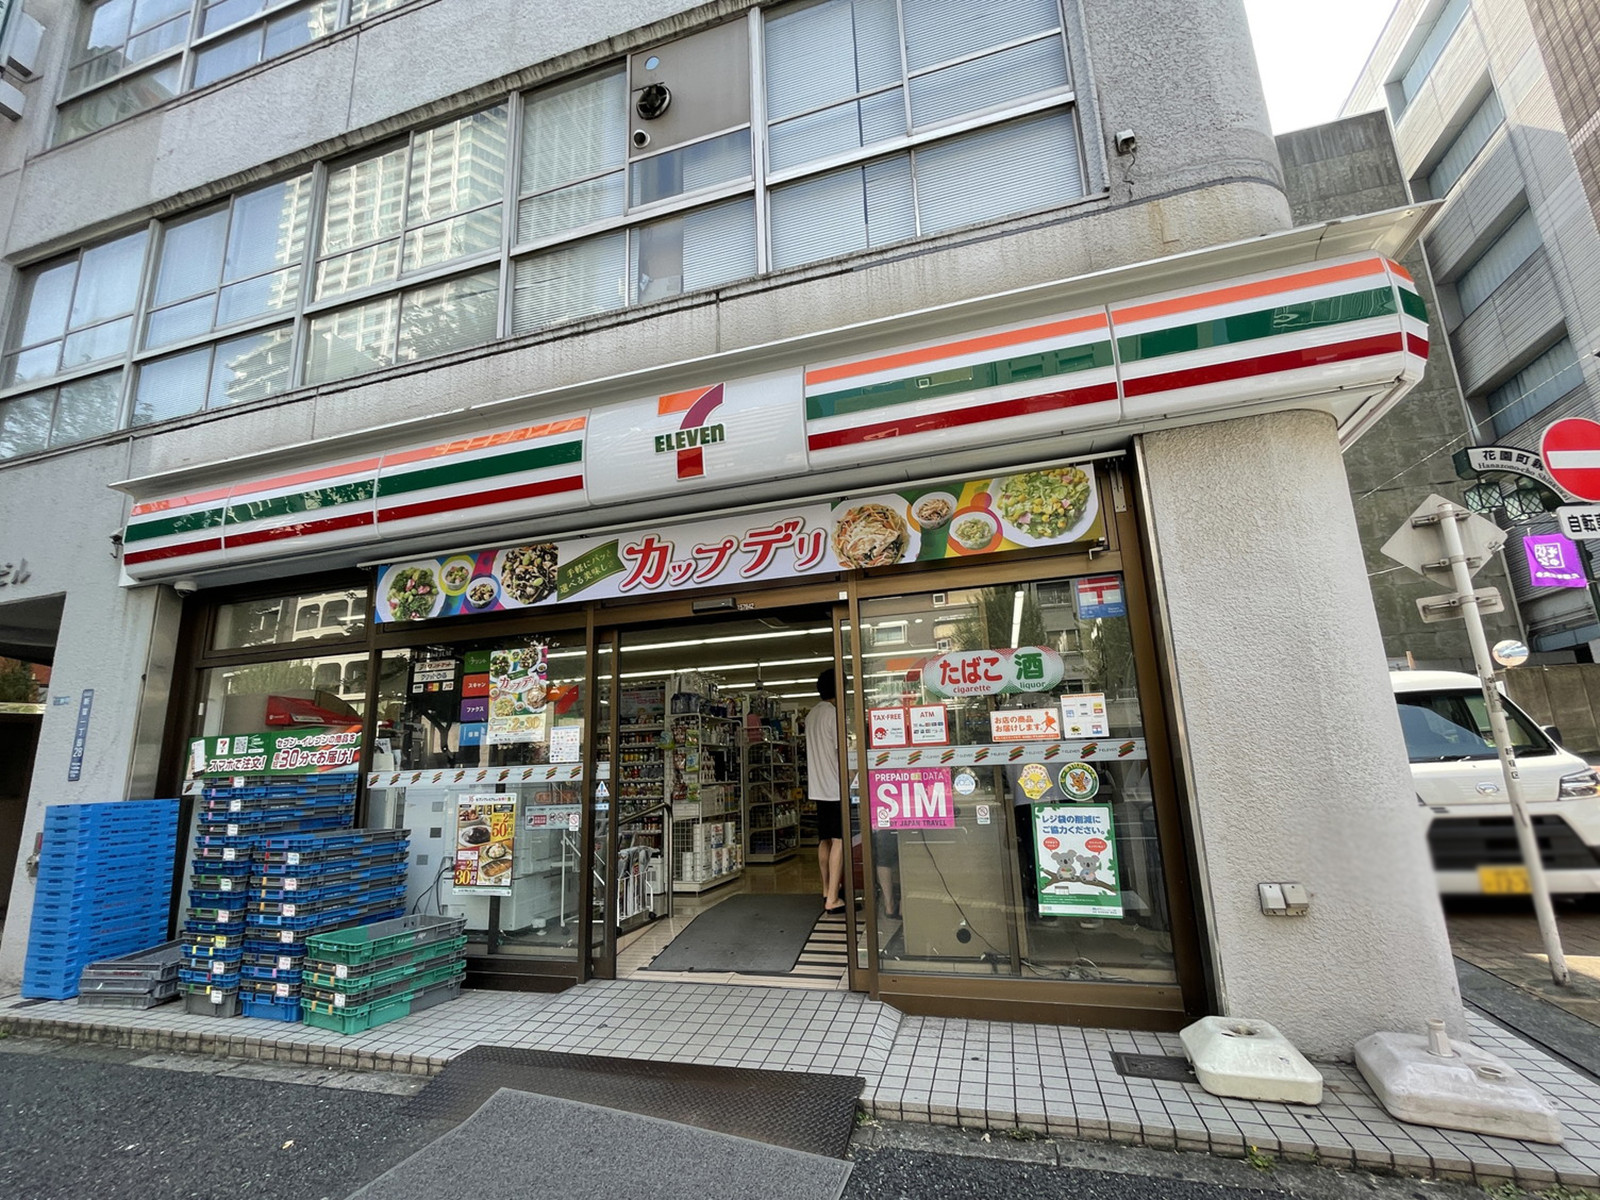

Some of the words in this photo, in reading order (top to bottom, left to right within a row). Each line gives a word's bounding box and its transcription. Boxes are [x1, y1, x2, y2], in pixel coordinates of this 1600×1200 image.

[620, 518, 824, 591] カップデリ
[939, 656, 1003, 686] たばこ
[1014, 652, 1044, 680] 酒
[953, 685, 992, 694] cigarette
[1020, 682, 1046, 690] liquor
[994, 715, 1034, 725] お店の商品
[875, 773, 909, 782] PREPAID
[922, 772, 944, 780] DATA
[876, 782, 947, 819] SIM
[1042, 815, 1102, 824] レジ袋の削減に
[1042, 826, 1106, 835] ご協力ください。
